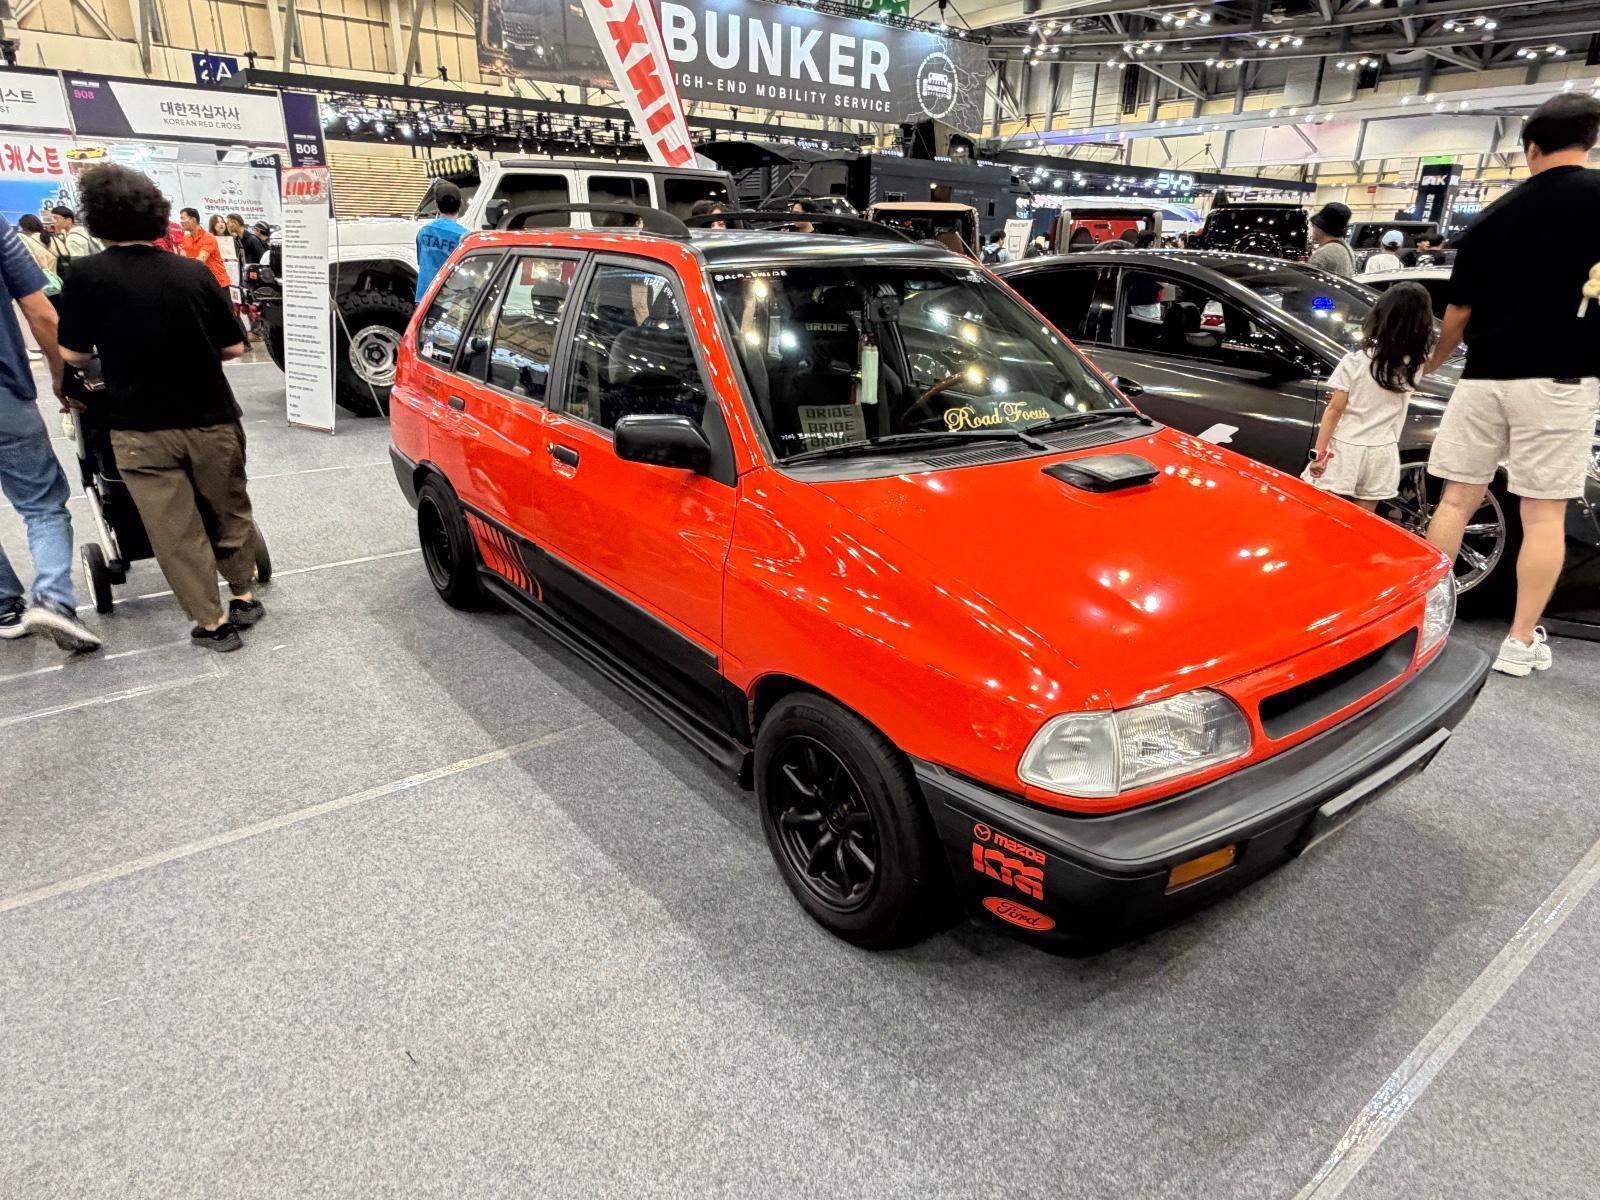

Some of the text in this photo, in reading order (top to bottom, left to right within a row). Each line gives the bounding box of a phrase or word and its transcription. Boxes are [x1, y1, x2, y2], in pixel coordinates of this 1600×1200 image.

[661, 2, 892, 93] BUNKER
[674, 73, 891, 112] IGH-END MOBILITY SERVICE
[160, 101, 240, 121] 대한적십자사
[163, 118, 242, 130] KOREAN RED CROSS
[295, 143, 318, 155] B08
[1157, 172, 1194, 191] BYD
[204, 197, 226, 206] Youth
[943, 401, 1050, 432] Road Focus
[996, 901, 1041, 926] Ford
